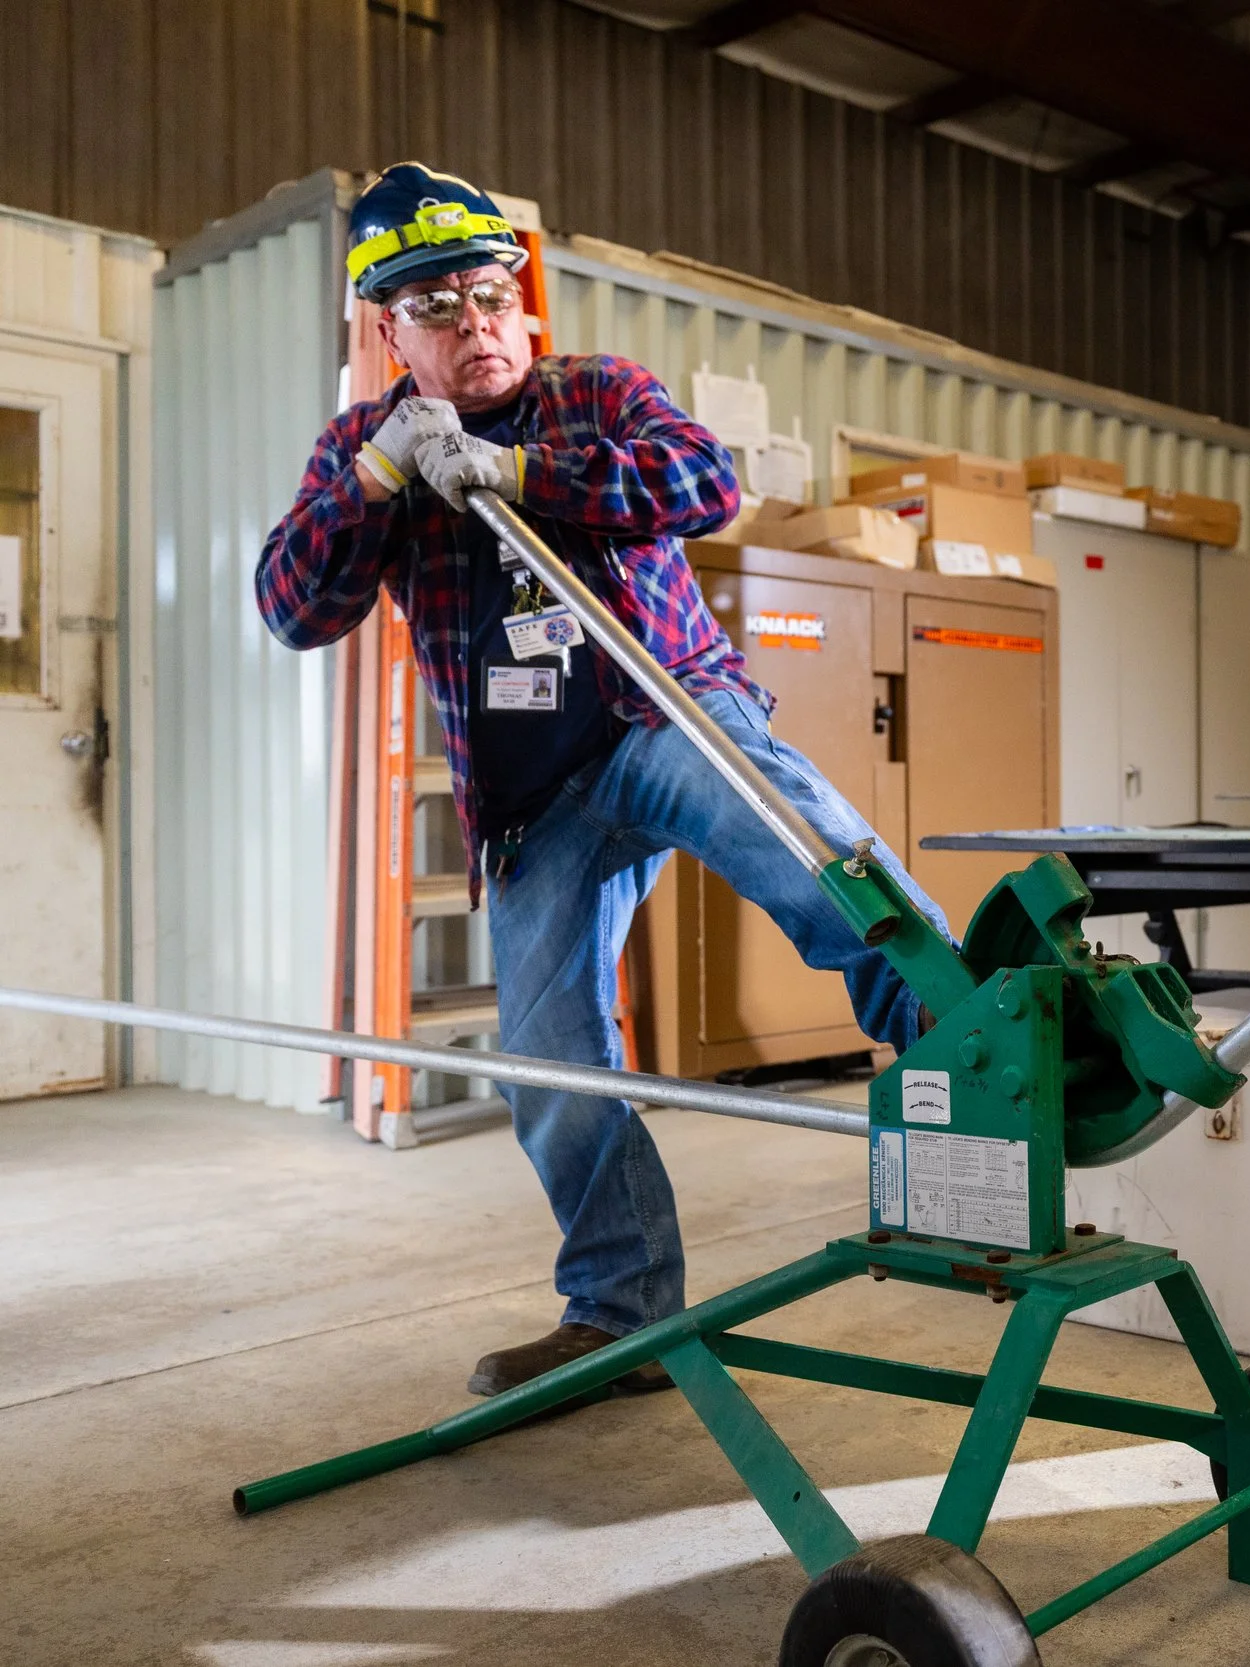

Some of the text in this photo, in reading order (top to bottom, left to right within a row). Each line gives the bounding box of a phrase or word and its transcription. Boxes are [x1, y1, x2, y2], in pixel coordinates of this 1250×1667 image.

[746, 615, 826, 640] KNAACK
[913, 1081, 938, 1089] RELEASE
[918, 1100, 934, 1108] BEND
